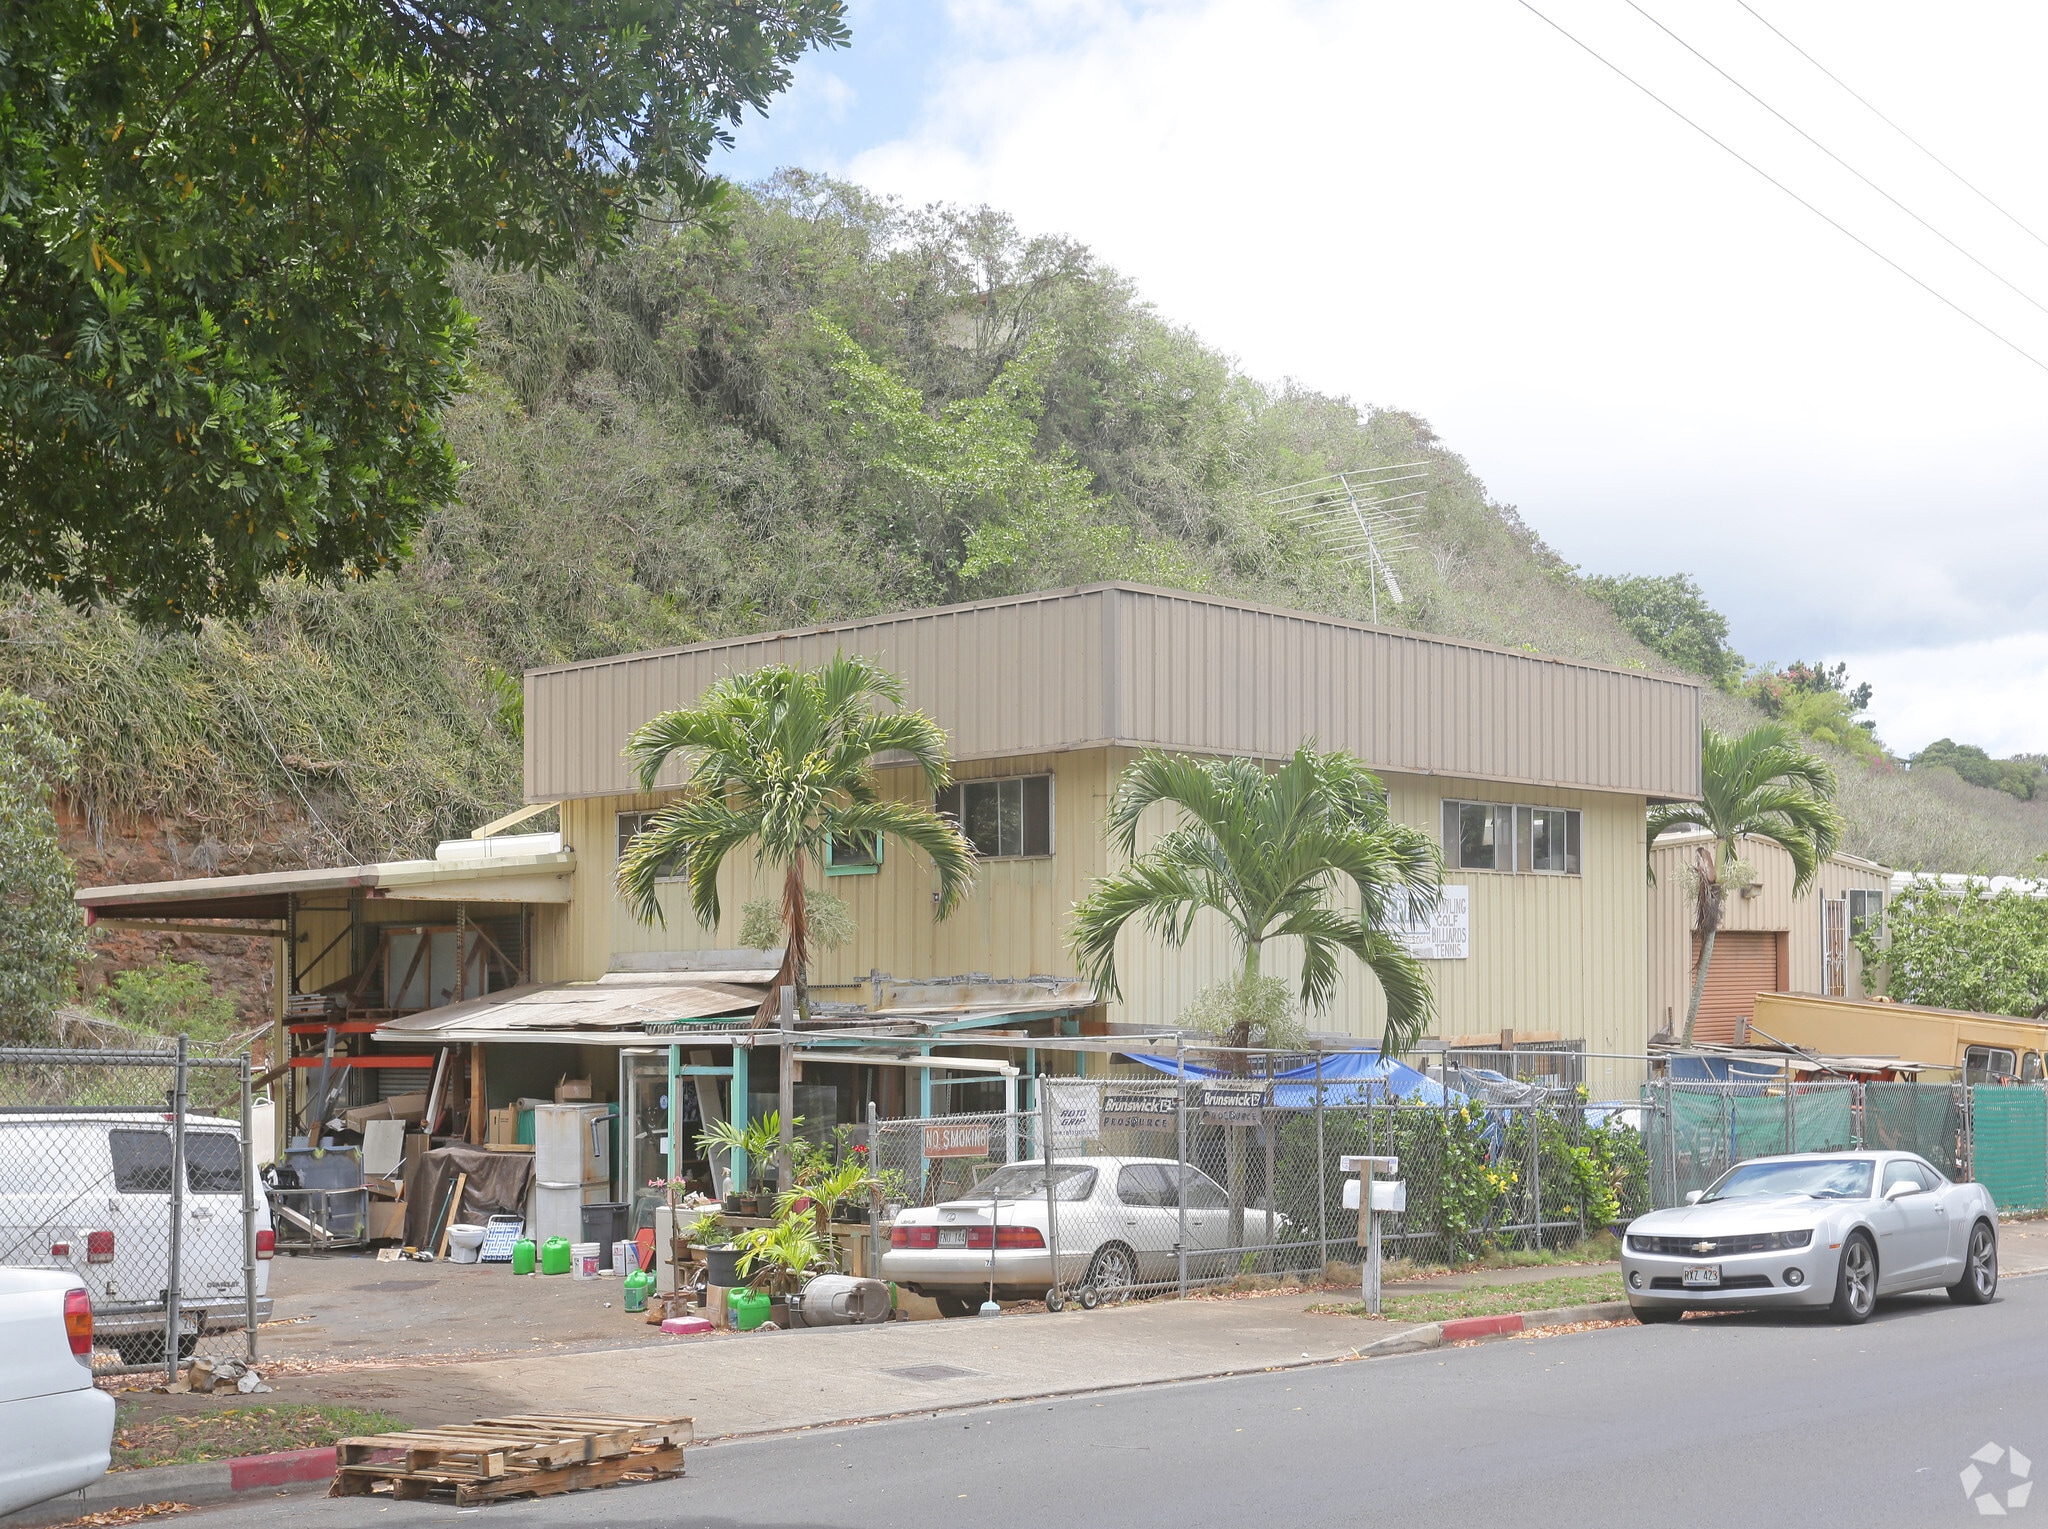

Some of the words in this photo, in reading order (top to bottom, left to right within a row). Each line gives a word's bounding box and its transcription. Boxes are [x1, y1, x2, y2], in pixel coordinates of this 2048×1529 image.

[1436, 914, 1458, 927] GOLF
[1431, 927, 1467, 943] BILLIARDS
[1434, 943, 1462, 957] TENNIS
[1104, 1098, 1159, 1112] Brunswick
[1204, 1091, 1250, 1106] Brunswick
[926, 1130, 939, 1148] NO
[943, 1127, 987, 1150] SMOKING
[1684, 1270, 1699, 1281] RXZ
[1703, 1269, 1718, 1281] 423
